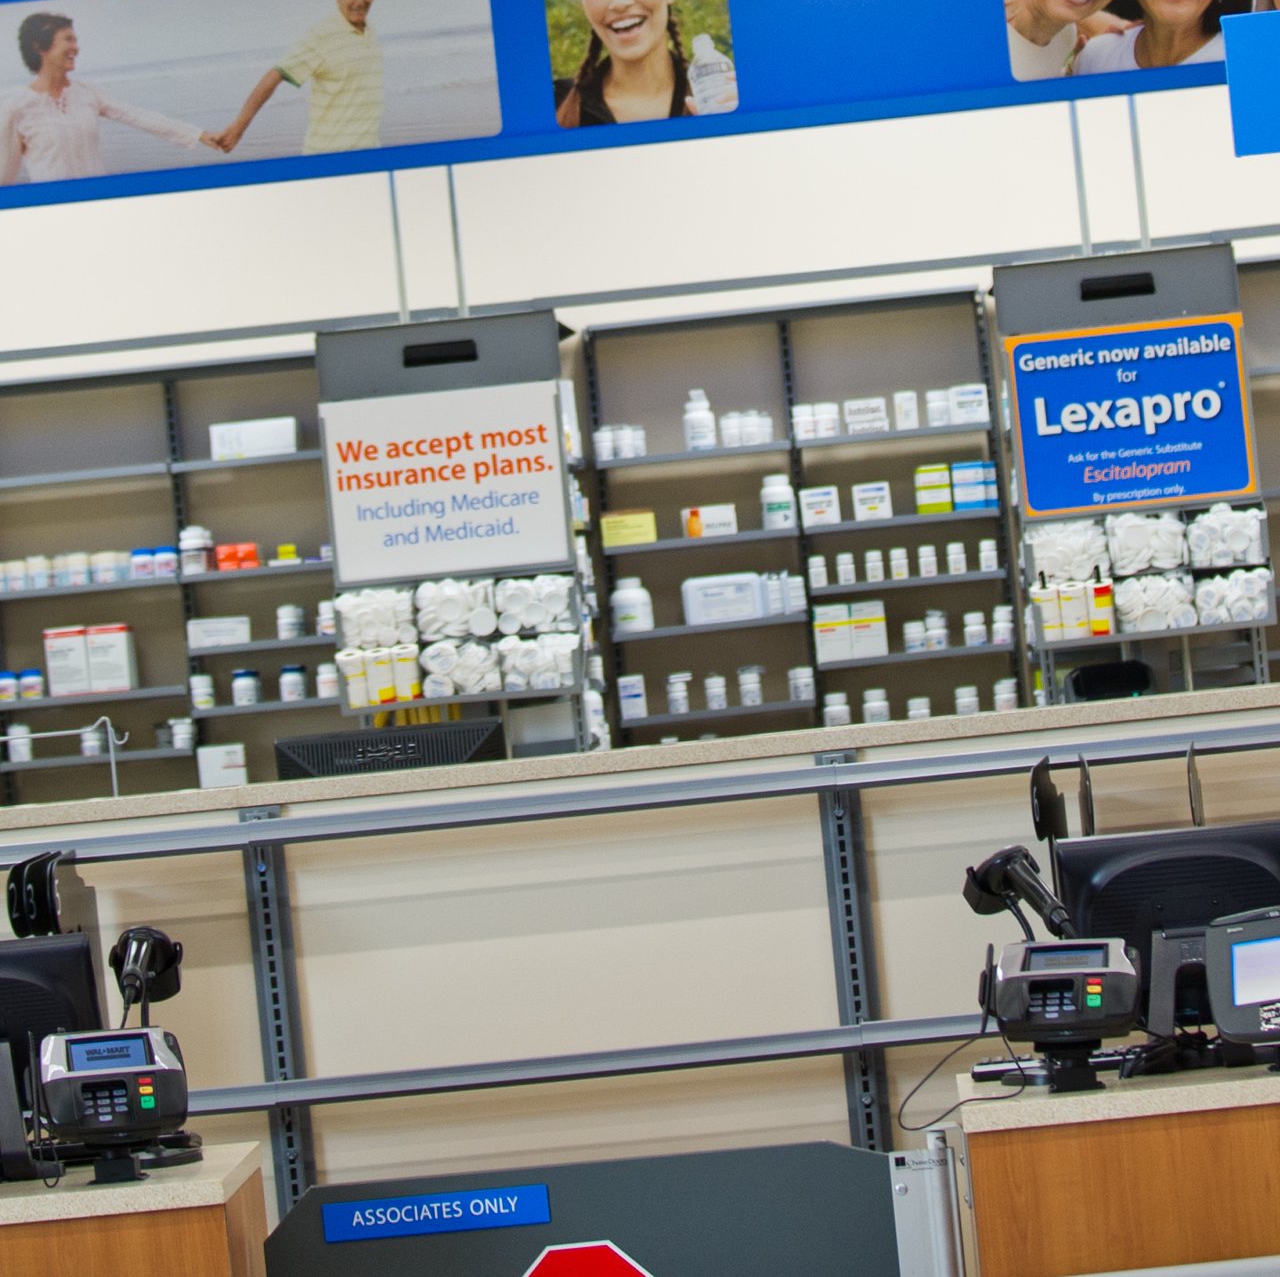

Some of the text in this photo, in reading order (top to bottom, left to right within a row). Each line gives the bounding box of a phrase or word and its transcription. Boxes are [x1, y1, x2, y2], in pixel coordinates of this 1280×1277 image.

[1019, 334, 1232, 372] Generic now available
[1116, 368, 1138, 383] for
[1034, 387, 1222, 436] Lexapro
[336, 424, 548, 463] We accept most
[1068, 442, 1203, 463] Ask for the Generic Substitute
[337, 453, 554, 492] insurance plans.
[1083, 460, 1191, 483] Escitalopram
[356, 490, 540, 521] Including Medicare
[1106, 487, 1162, 503] prescription
[383, 516, 520, 548] and Medicaid.
[9, 882, 19, 919] 2
[26, 883, 37, 920] 3
[352, 1196, 518, 1227] ASSOCIATES ONLY
